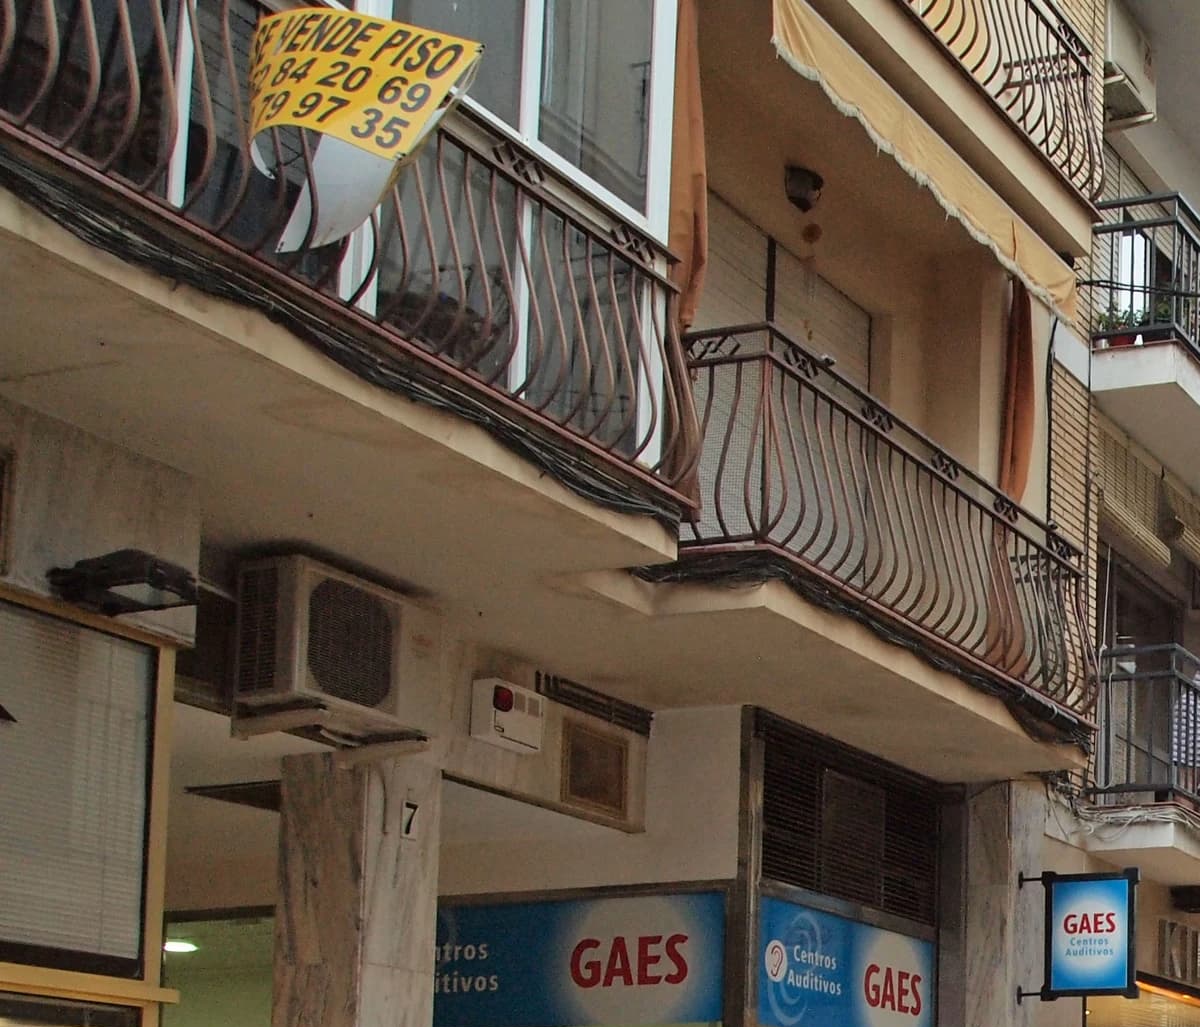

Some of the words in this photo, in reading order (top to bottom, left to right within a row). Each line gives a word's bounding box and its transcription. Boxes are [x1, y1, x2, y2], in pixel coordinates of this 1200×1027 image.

[275, 13, 386, 57] VENDE
[369, 29, 464, 79] PISO
[271, 57, 317, 87] 84
[316, 61, 373, 93] 20
[377, 75, 432, 113] 69
[291, 91, 351, 123] 97
[350, 108, 410, 149] 35
[405, 802, 418, 835] 7
[1063, 912, 1117, 935] GAES
[793, 944, 837, 971] Centros
[1065, 946, 1114, 958] Auditivos
[1070, 936, 1109, 947] Centros
[570, 933, 689, 989] GAES
[787, 969, 842, 997] Auditivos
[863, 963, 922, 1017] GAES
